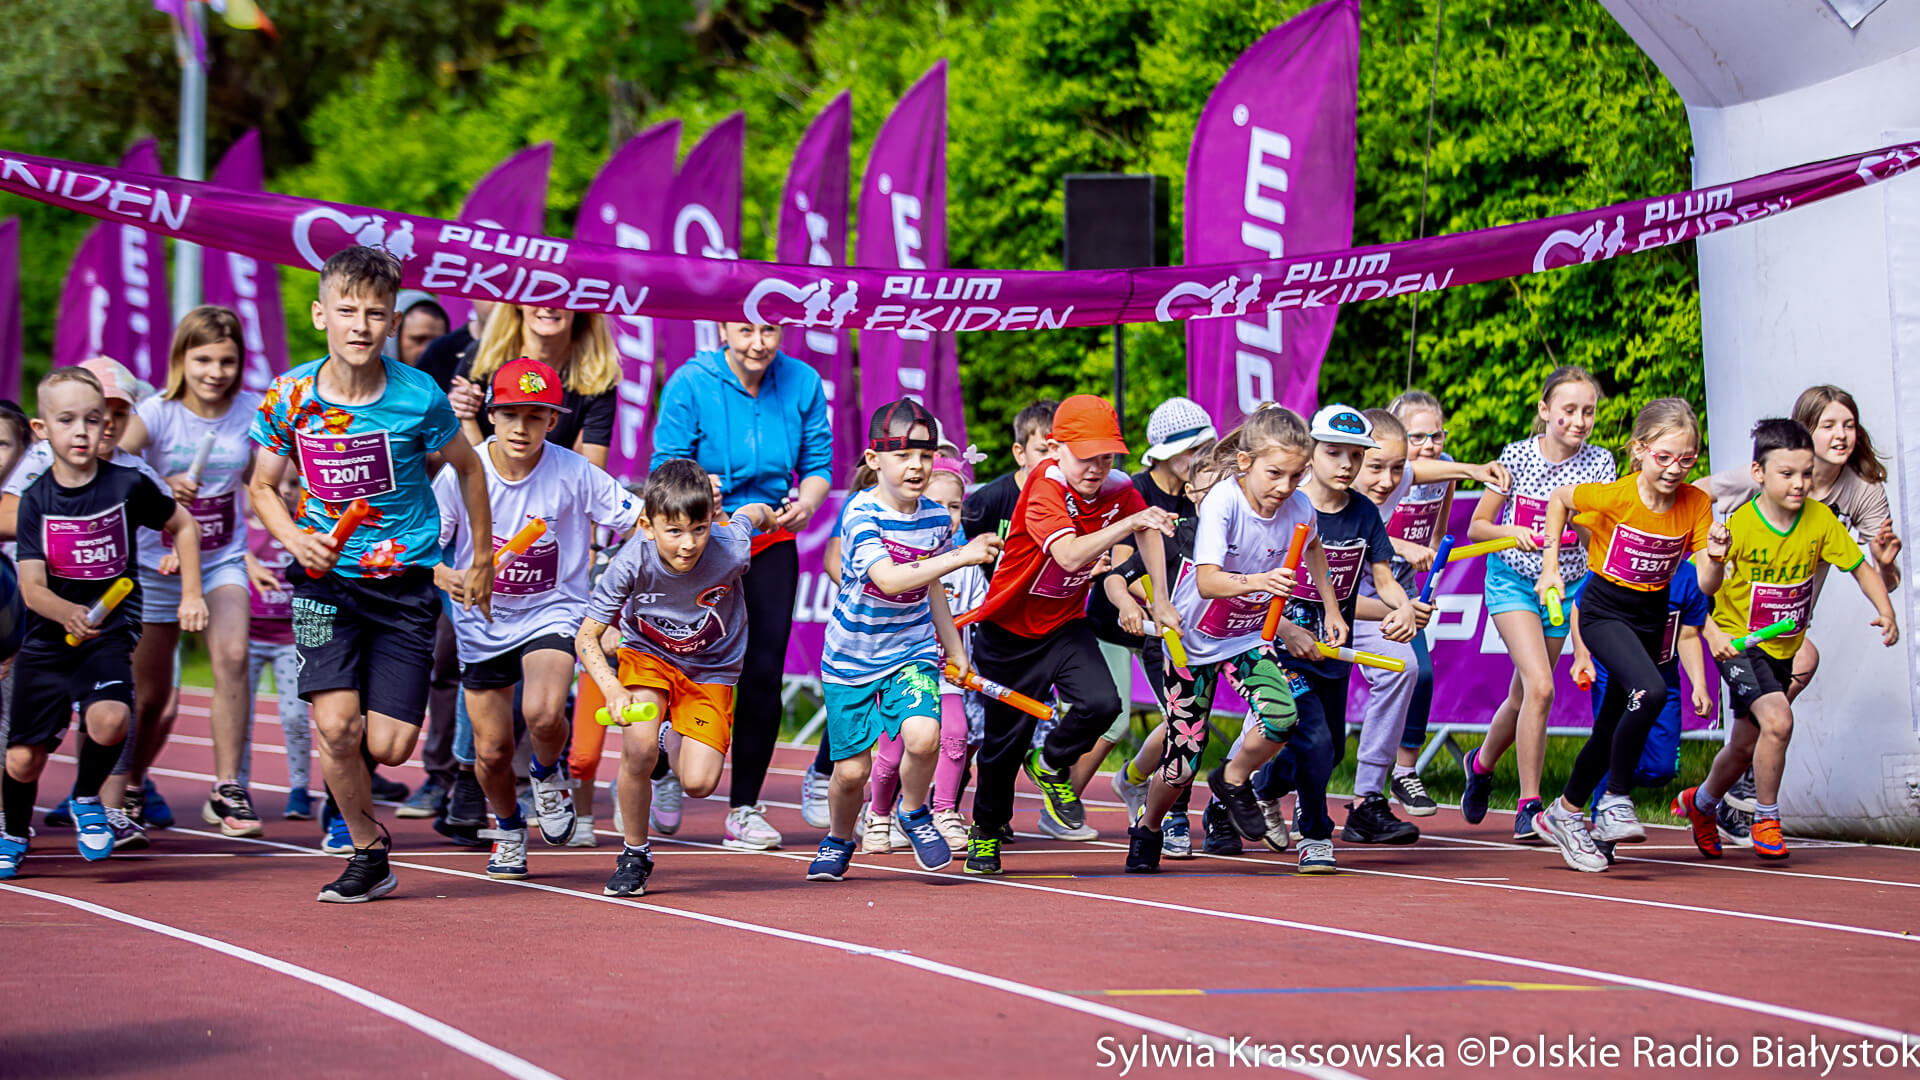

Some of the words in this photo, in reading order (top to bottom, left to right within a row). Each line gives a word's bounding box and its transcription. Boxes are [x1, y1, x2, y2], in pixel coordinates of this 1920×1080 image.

[1645, 187, 1733, 226] PLUM
[438, 225, 569, 265] PLUM
[1285, 252, 1391, 286] PLUM
[422, 252, 650, 315] EKIDEN
[882, 276, 1003, 300] PLUM
[1267, 267, 1455, 311] EKIDEN
[864, 305, 1074, 331] EKIDEN
[319, 465, 371, 483] 120/1
[1403, 526, 1430, 540] 138/1
[71, 543, 118, 564] 134/1
[1630, 557, 1671, 572] 133/1
[1750, 548, 1769, 565] 11
[1751, 564, 1813, 583] BRAZI
[1226, 615, 1264, 629] 121/1
